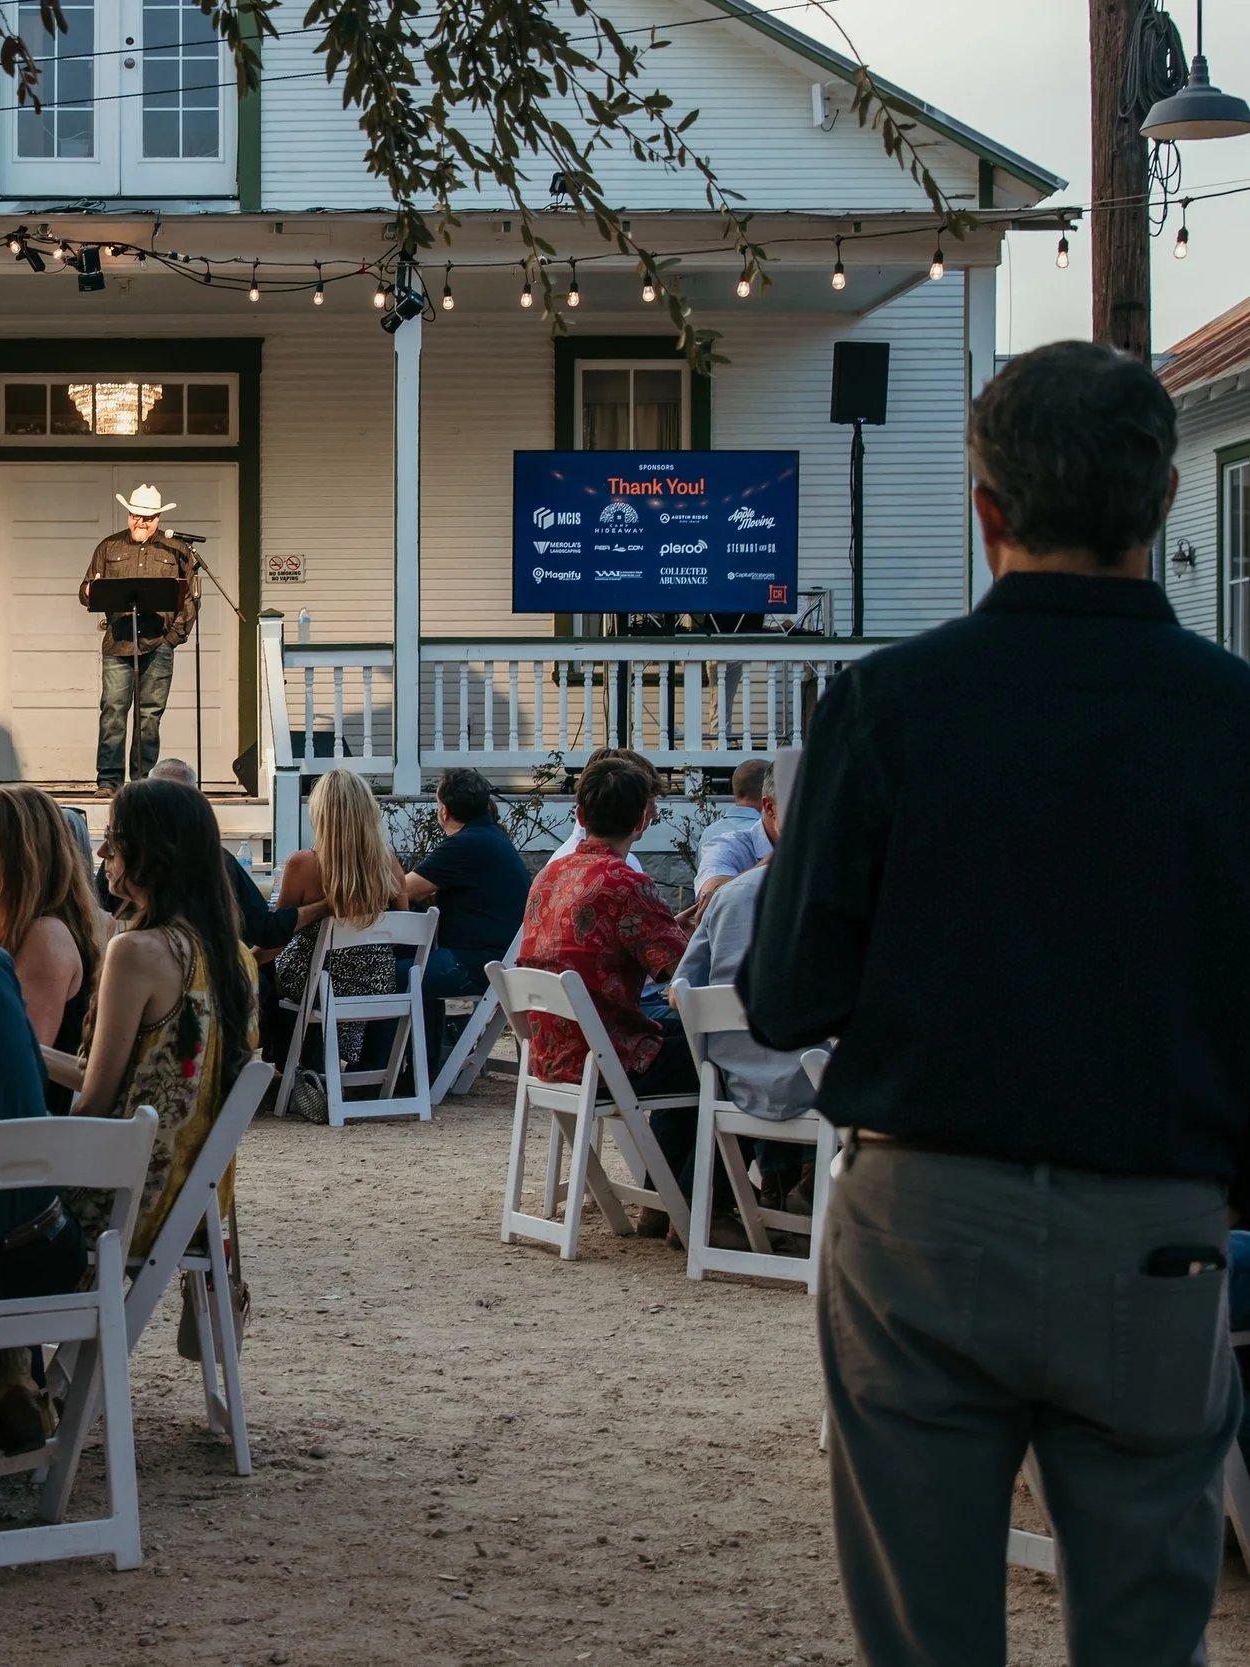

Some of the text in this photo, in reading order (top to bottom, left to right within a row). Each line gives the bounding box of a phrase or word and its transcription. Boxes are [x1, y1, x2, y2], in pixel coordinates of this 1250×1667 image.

[607, 478, 705, 495] Thank You!
[557, 512, 581, 525] MCIS
[728, 506, 755, 522] Apple
[737, 515, 776, 531] Moving
[659, 542, 704, 557] pleroo
[726, 543, 758, 553] STEWART
[545, 570, 581, 581] Magnify
[659, 567, 708, 576] COLLECTED
[658, 576, 709, 585] ABUNDANCE
